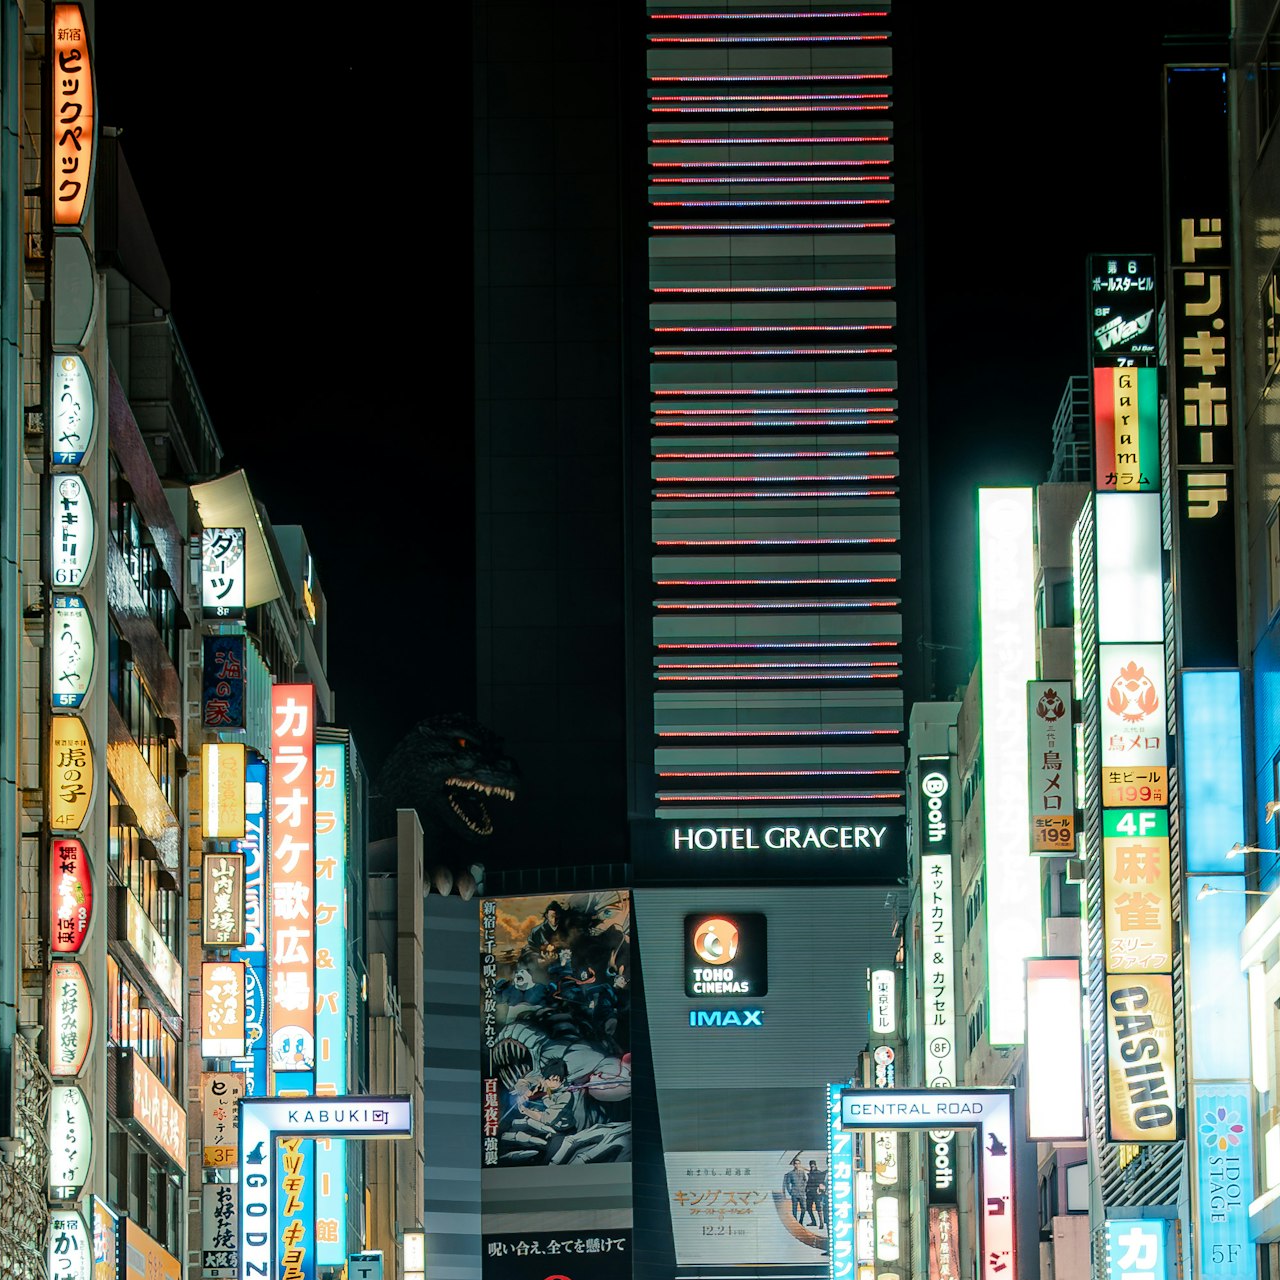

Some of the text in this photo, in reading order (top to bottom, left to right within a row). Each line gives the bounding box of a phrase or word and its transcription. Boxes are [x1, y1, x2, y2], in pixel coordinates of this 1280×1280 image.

[57, 28, 81, 41] 新宿
[1128, 261, 1138, 274] 6
[1094, 307, 1111, 317] 8F
[1097, 309, 1154, 350] Way
[1117, 375, 1137, 464] Garam
[60, 452, 76, 463] 7F
[1105, 472, 1151, 486] ガラム
[211, 535, 235, 600] ダーツ
[55, 568, 82, 584] 6F
[216, 606, 230, 617] 8F
[205, 651, 242, 727] 海の家
[59, 694, 77, 707] 5F
[1046, 726, 1057, 748] 三代目
[56, 748, 86, 803] 虎の子
[1109, 771, 1161, 783] 生ビール
[55, 814, 75, 826] 4F
[1035, 817, 1070, 828] 生ビール
[1116, 812, 1157, 836] 4F
[674, 826, 887, 850] HOTEL GRACERY
[1040, 828, 1071, 842] 199
[273, 697, 311, 1012] カラオケ歌広場
[210, 858, 237, 931] 山内農場
[1114, 844, 1162, 931] 麻雀
[216, 931, 231, 943] 5F
[931, 864, 946, 1026] ネットカフェ & カプセル
[1111, 937, 1154, 952] スリー
[1110, 953, 1168, 969] ファイブ
[693, 969, 734, 982] TOHO
[693, 981, 750, 994] CINEMAS
[878, 982, 889, 1027] 東京ビル
[61, 981, 78, 1064] お好み焼き
[689, 1010, 764, 1027] IMAX
[933, 1042, 948, 1053] 8F
[1110, 986, 1173, 1130] CASINO
[850, 1102, 984, 1116] CENTRAL ROAD
[63, 1110, 79, 1182] とらそば
[213, 1149, 234, 1162] 3F
[1209, 1156, 1226, 1223] STAGE
[1225, 1156, 1241, 1209] IDOL
[55, 1186, 76, 1198] 1F
[673, 1190, 769, 1208] キングスマン
[54, 1219, 79, 1231] 新宿
[488, 1237, 627, 1257] 呪い合え、全てを懸けて
[1211, 1243, 1242, 1264] 5F
